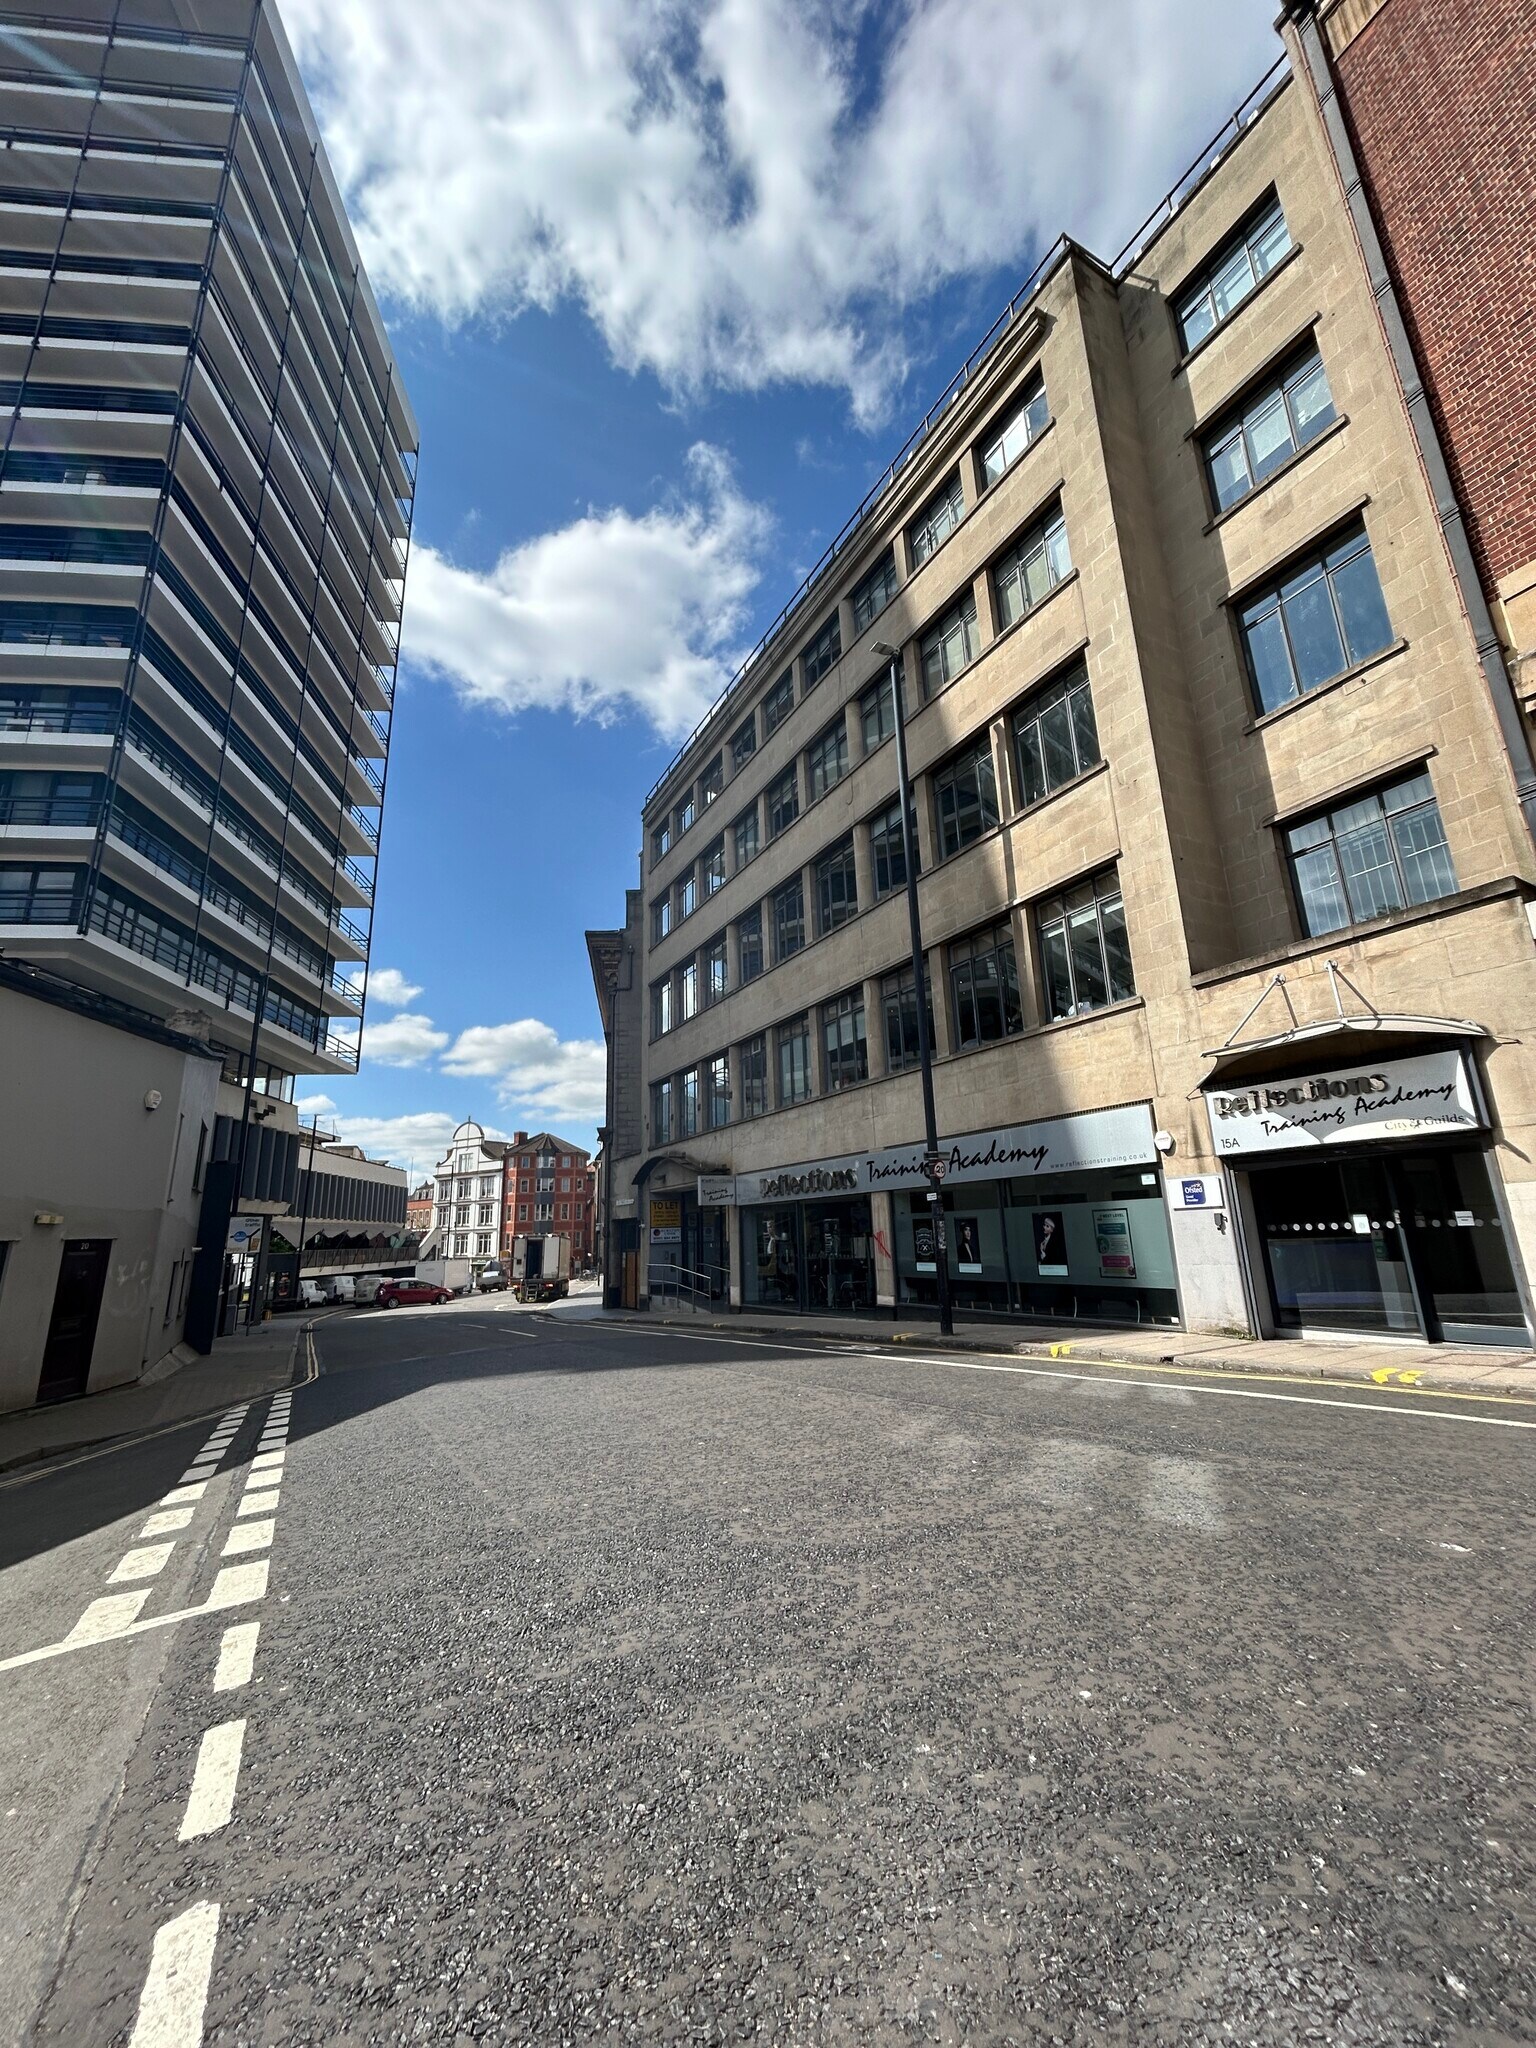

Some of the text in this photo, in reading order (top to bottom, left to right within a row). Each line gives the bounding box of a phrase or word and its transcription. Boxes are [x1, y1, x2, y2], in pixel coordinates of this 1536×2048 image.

[1214, 1074, 1388, 1115] Reflections
[1261, 1084, 1456, 1136] Training Academy
[1385, 1120, 1407, 1131] City
[1425, 1114, 1464, 1126] Guilds
[1221, 1138, 1240, 1149] 15A
[760, 1139, 1049, 1198] Reflections Trainin Academy
[936, 1165, 945, 1175] 20
[1184, 1186, 1203, 1194] Ofsted
[652, 1201, 678, 1210] TO LET
[81, 1242, 90, 1250] 20
